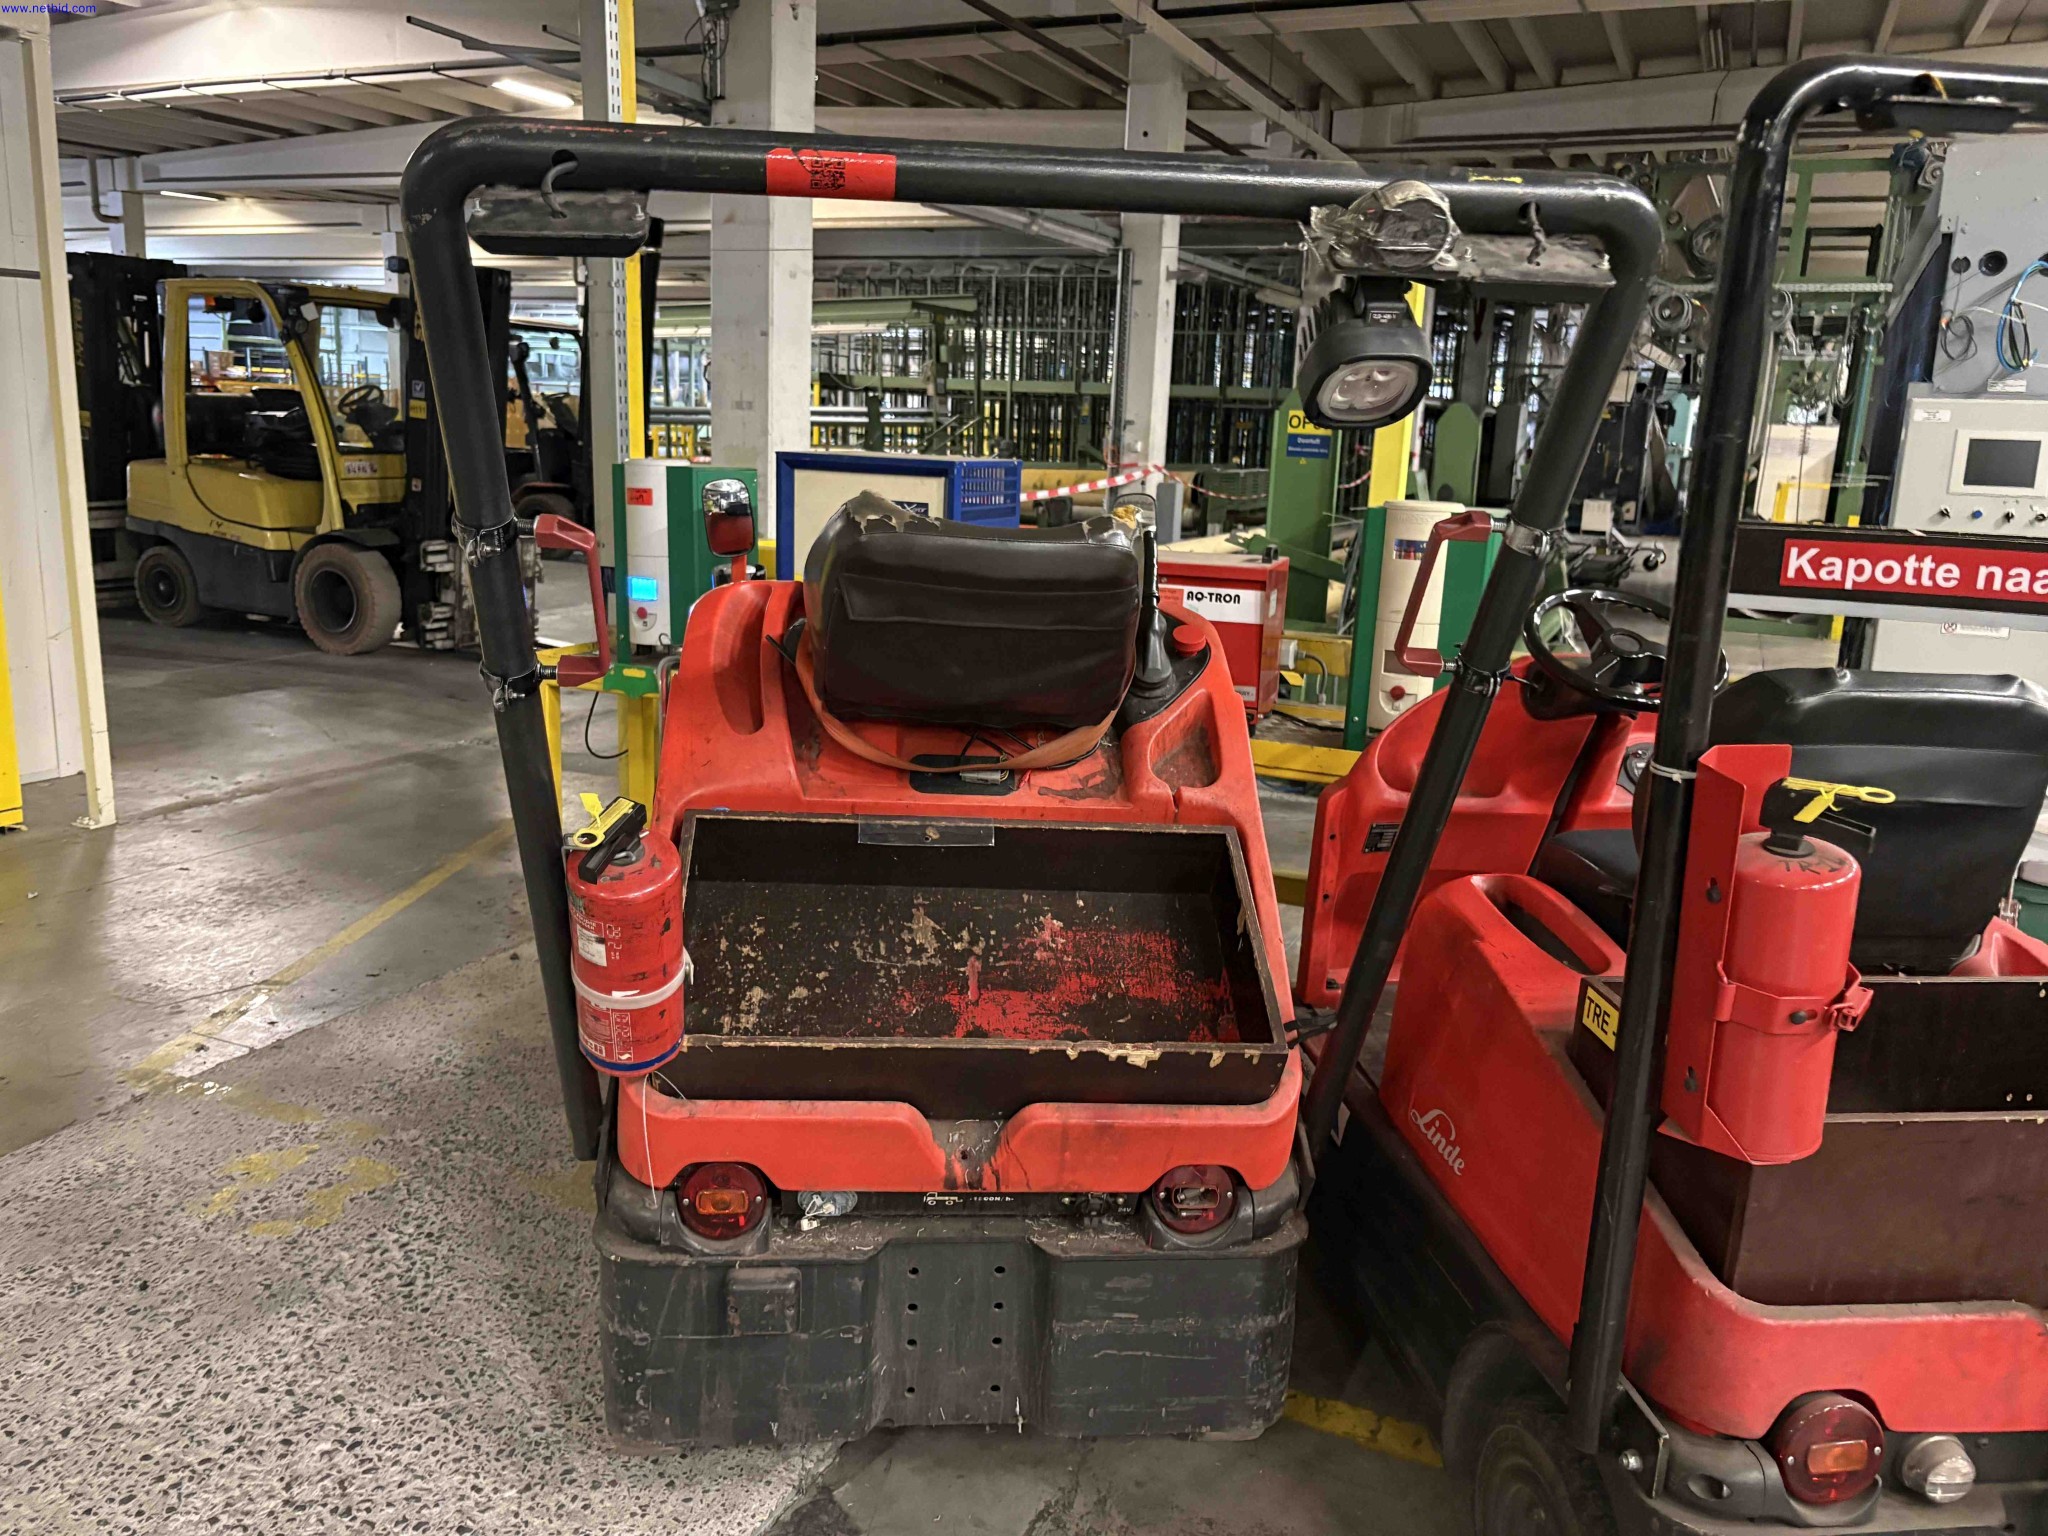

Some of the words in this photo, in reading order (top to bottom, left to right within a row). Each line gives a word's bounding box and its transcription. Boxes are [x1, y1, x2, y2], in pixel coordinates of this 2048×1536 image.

[1786, 546, 1961, 590] Kapotte
[1585, 995, 1611, 1037] TRE
[1410, 1108, 1465, 1176] Linde
